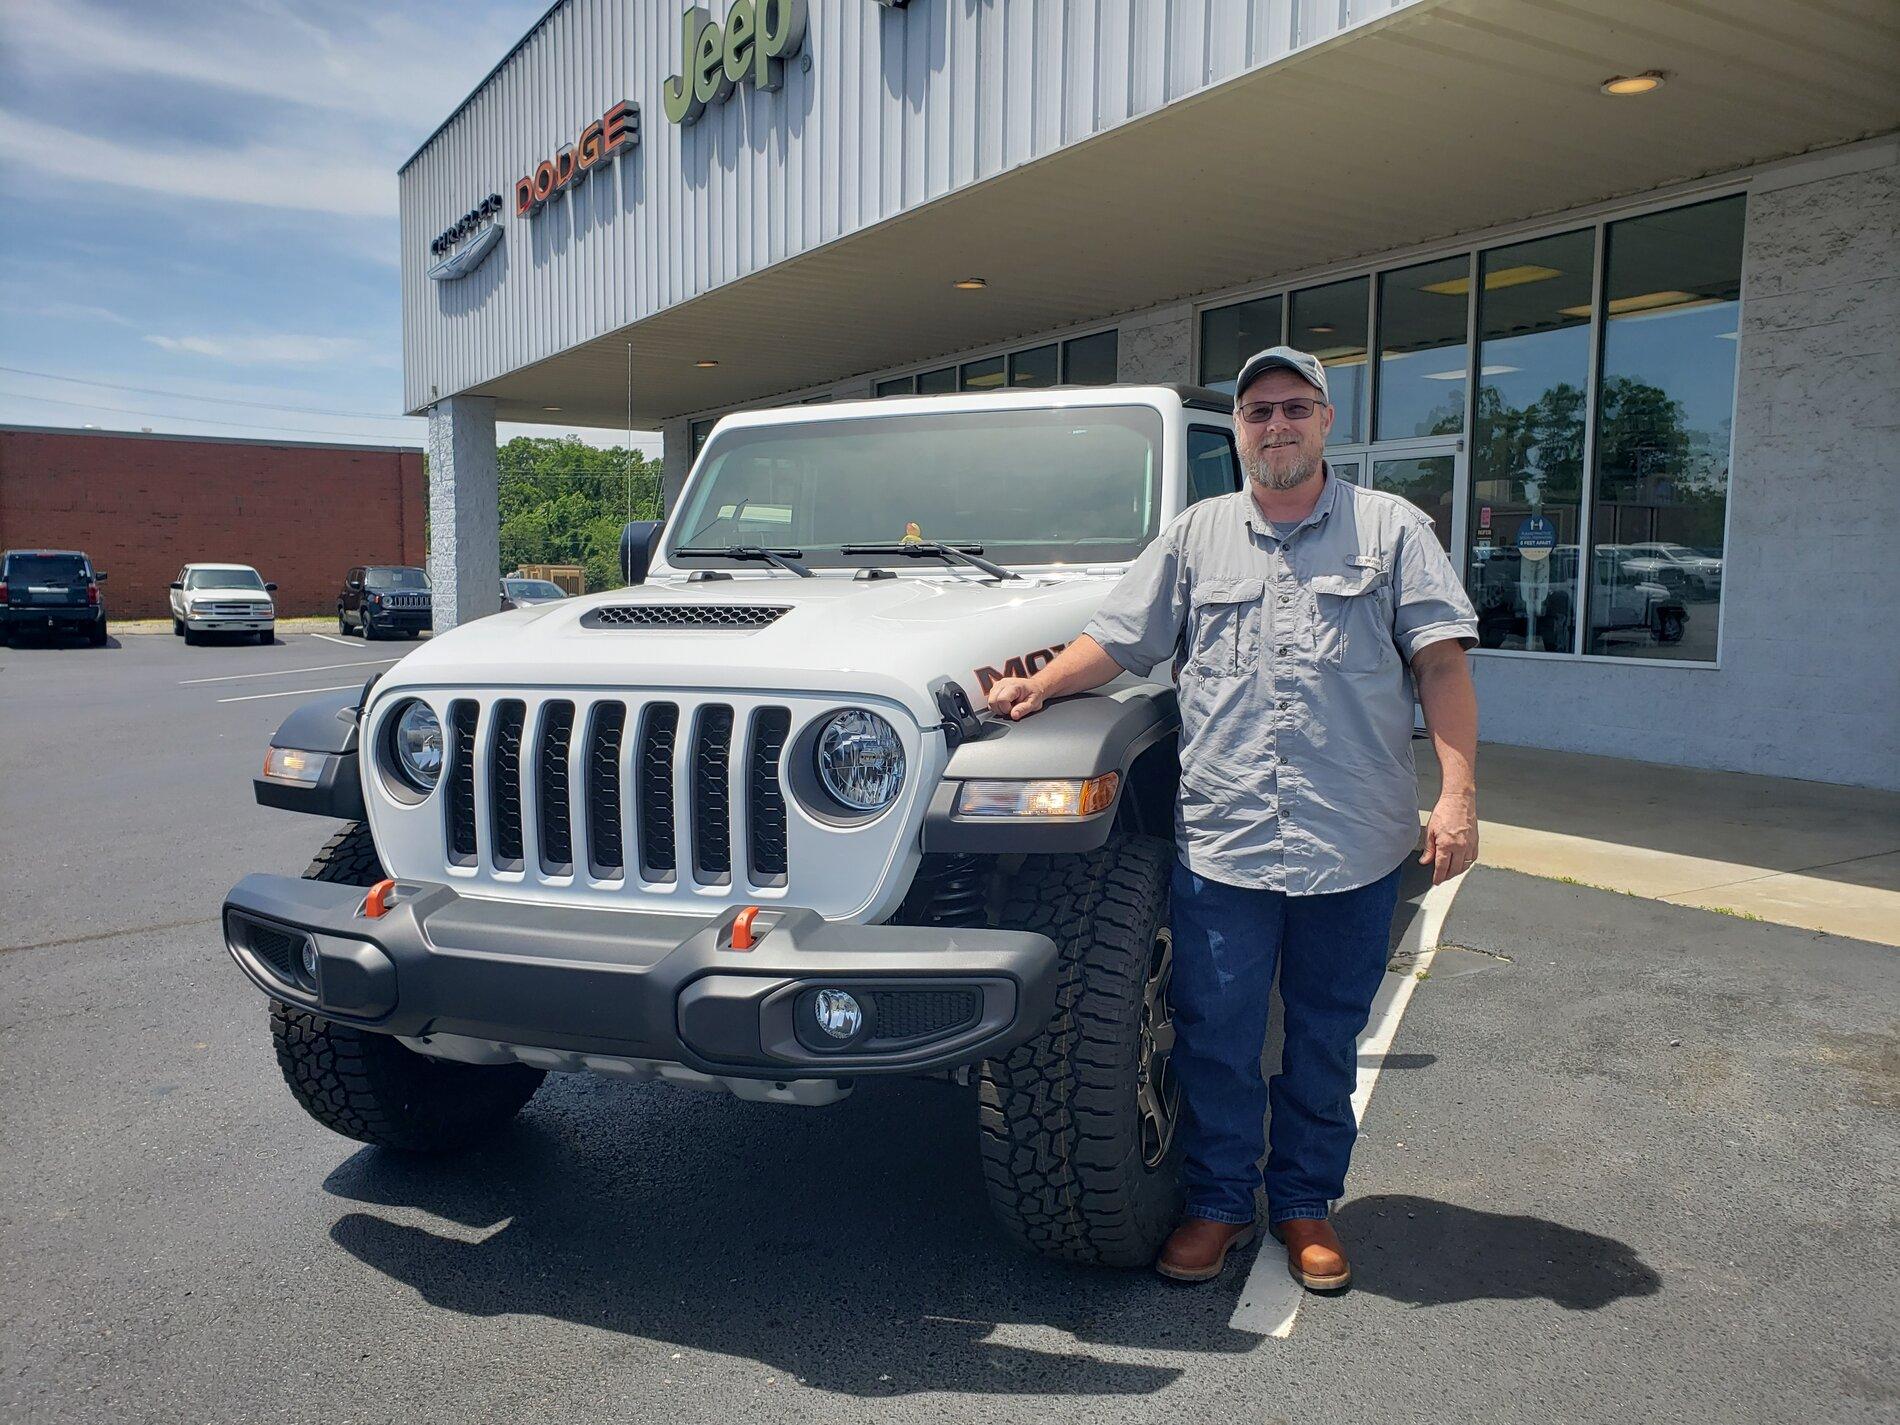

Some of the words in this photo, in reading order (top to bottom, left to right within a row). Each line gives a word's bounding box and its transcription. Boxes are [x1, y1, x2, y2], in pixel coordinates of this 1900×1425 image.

[664, 0, 808, 125] Jeep
[515, 99, 640, 219] DODGE
[431, 193, 503, 256] CHRYSLER
[974, 641, 1074, 697] MO
